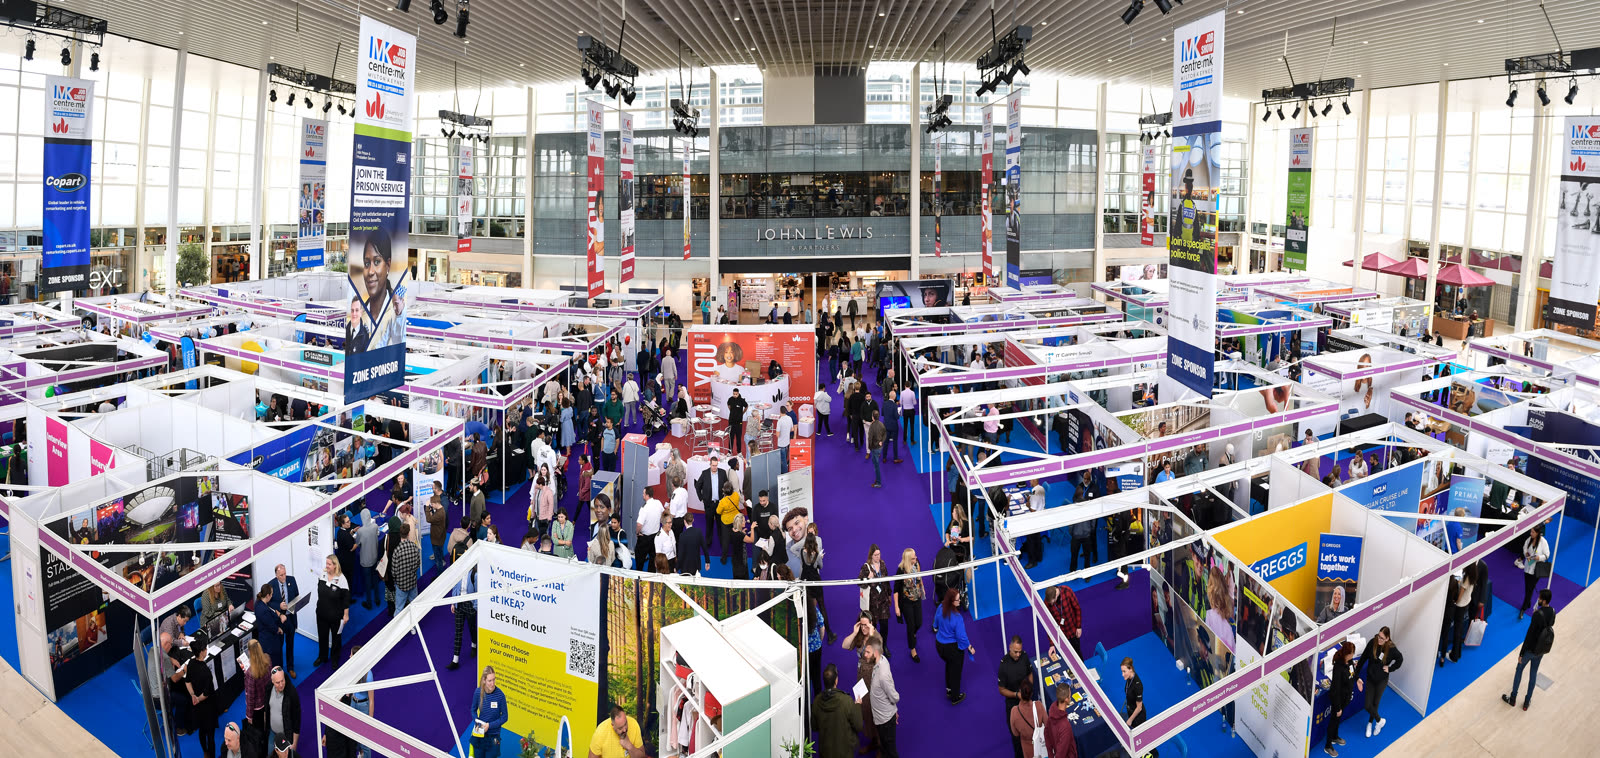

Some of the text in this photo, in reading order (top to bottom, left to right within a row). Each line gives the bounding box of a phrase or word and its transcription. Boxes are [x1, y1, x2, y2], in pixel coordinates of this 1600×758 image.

[397, 47, 406, 58] JOB
[1201, 43, 1214, 54] SHOW
[393, 55, 405, 66] SHOW
[1181, 55, 1213, 73] centre:mk
[368, 61, 405, 80] centre:mk
[46, 176, 81, 188] Copart
[356, 169, 384, 180] JOIN THE
[356, 182, 403, 192] PRISON SERVICE
[757, 227, 873, 242] JOHN LEWIS
[1171, 236, 1182, 246] Join
[1187, 240, 1210, 251] specialist
[1171, 249, 1200, 262] police force
[48, 274, 84, 284] ZONE SPONSOR
[90, 268, 122, 289] ext
[1553, 306, 1589, 320] ZONE SPONSOR
[353, 361, 398, 384] ZONE SPONSOR
[694, 344, 717, 387] YOU
[1172, 353, 1206, 379] ZONE SPONSOR
[1132, 415, 1159, 424] CHARLES
[1530, 418, 1544, 427] ALPHA
[46, 432, 67, 450] Interview
[52, 445, 63, 458] Area
[1147, 452, 1188, 468] our Perfect
[1541, 462, 1558, 473] BUSINESS
[279, 461, 299, 476] Copart
[1380, 488, 1408, 504] CRUISE LINE
[1554, 481, 1596, 499] www.alpha.solutions
[1386, 501, 1396, 510] LTD.
[1321, 553, 1356, 564] Let's work
[1320, 562, 1349, 572] together
[194, 575, 207, 584] Stadium
[490, 566, 564, 591] Wnderin hat
[490, 579, 557, 604] it's to work
[490, 595, 525, 610] at IKEA?
[490, 609, 547, 634] Let's find out
[490, 638, 530, 656] You can choose
[503, 651, 514, 659] own
[515, 655, 528, 664] path
[1193, 683, 1238, 712] British Transport Police
[1252, 687, 1268, 707] olice
[1251, 694, 1268, 719] force
